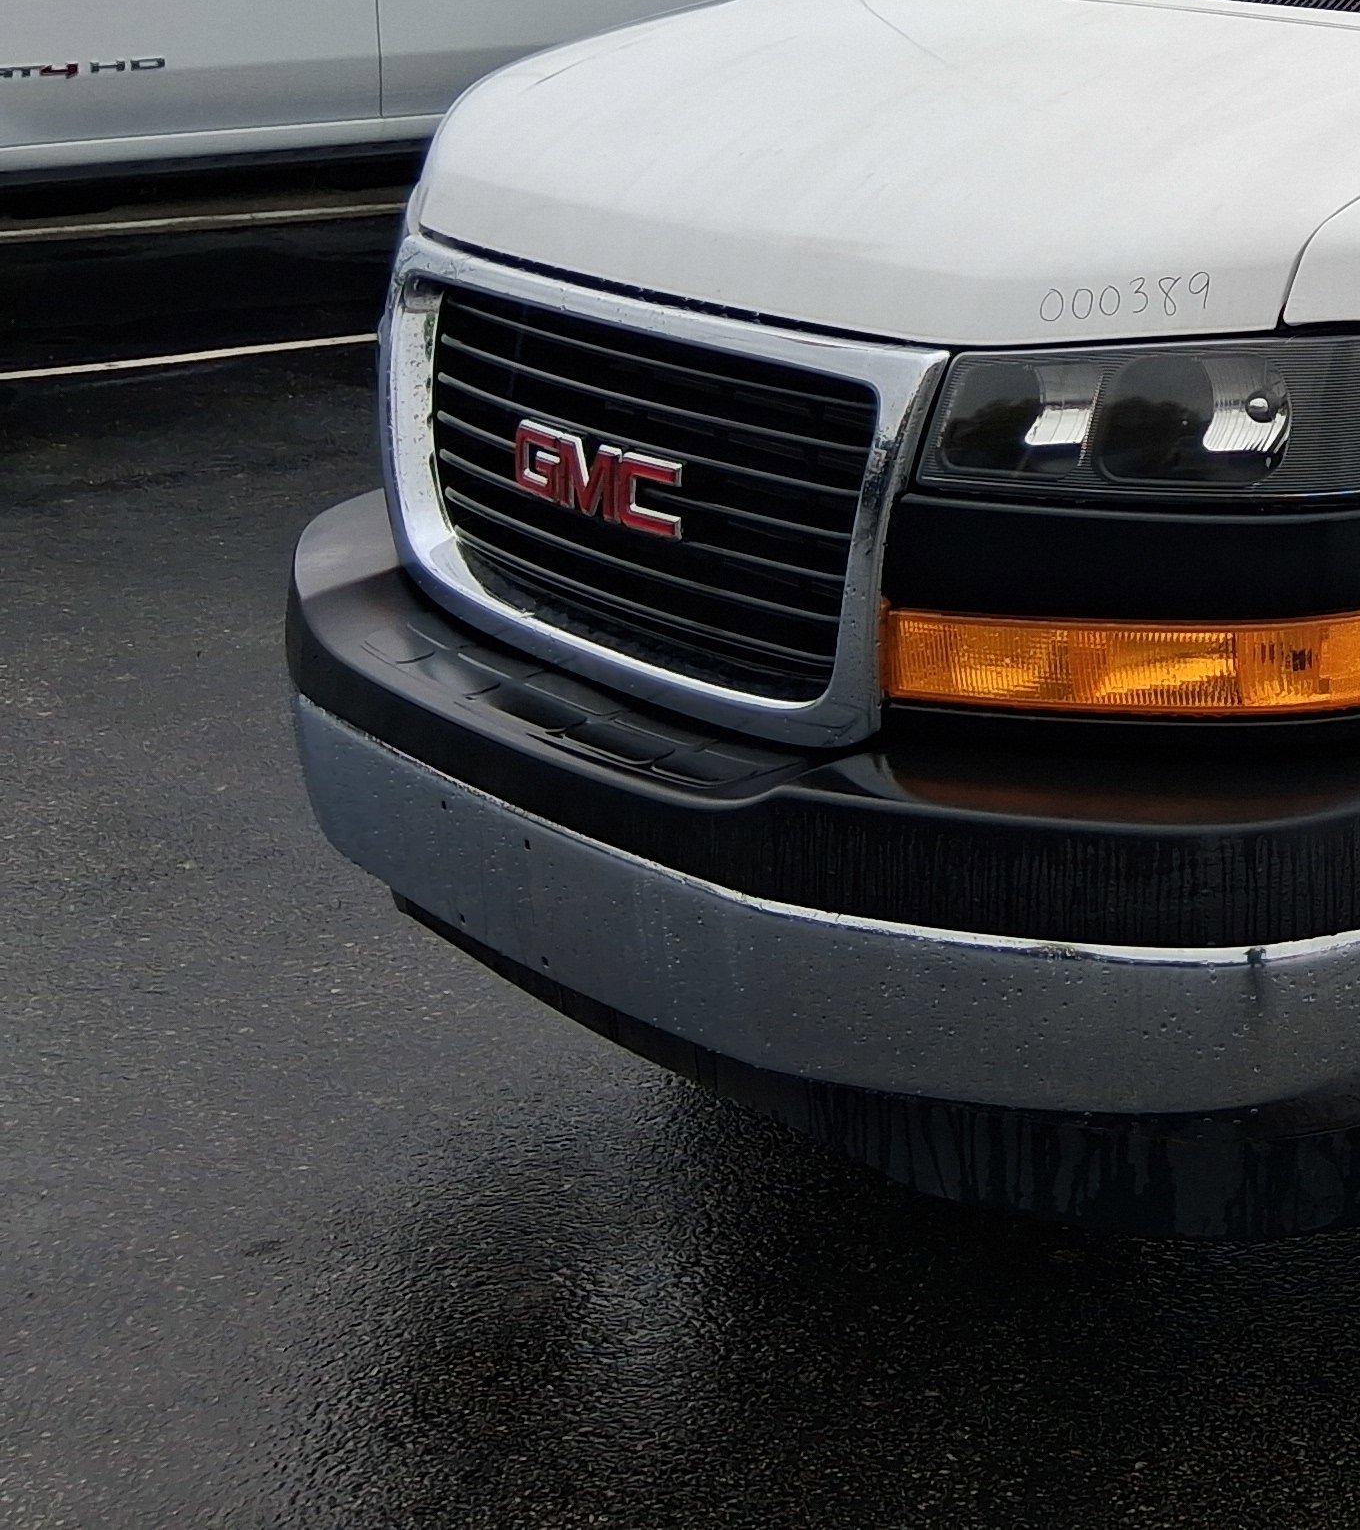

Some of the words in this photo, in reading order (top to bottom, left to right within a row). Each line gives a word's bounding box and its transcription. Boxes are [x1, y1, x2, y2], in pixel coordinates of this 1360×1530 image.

[91, 58, 165, 74] HD
[1039, 271, 1211, 322] 000389
[515, 419, 683, 542] GMC
